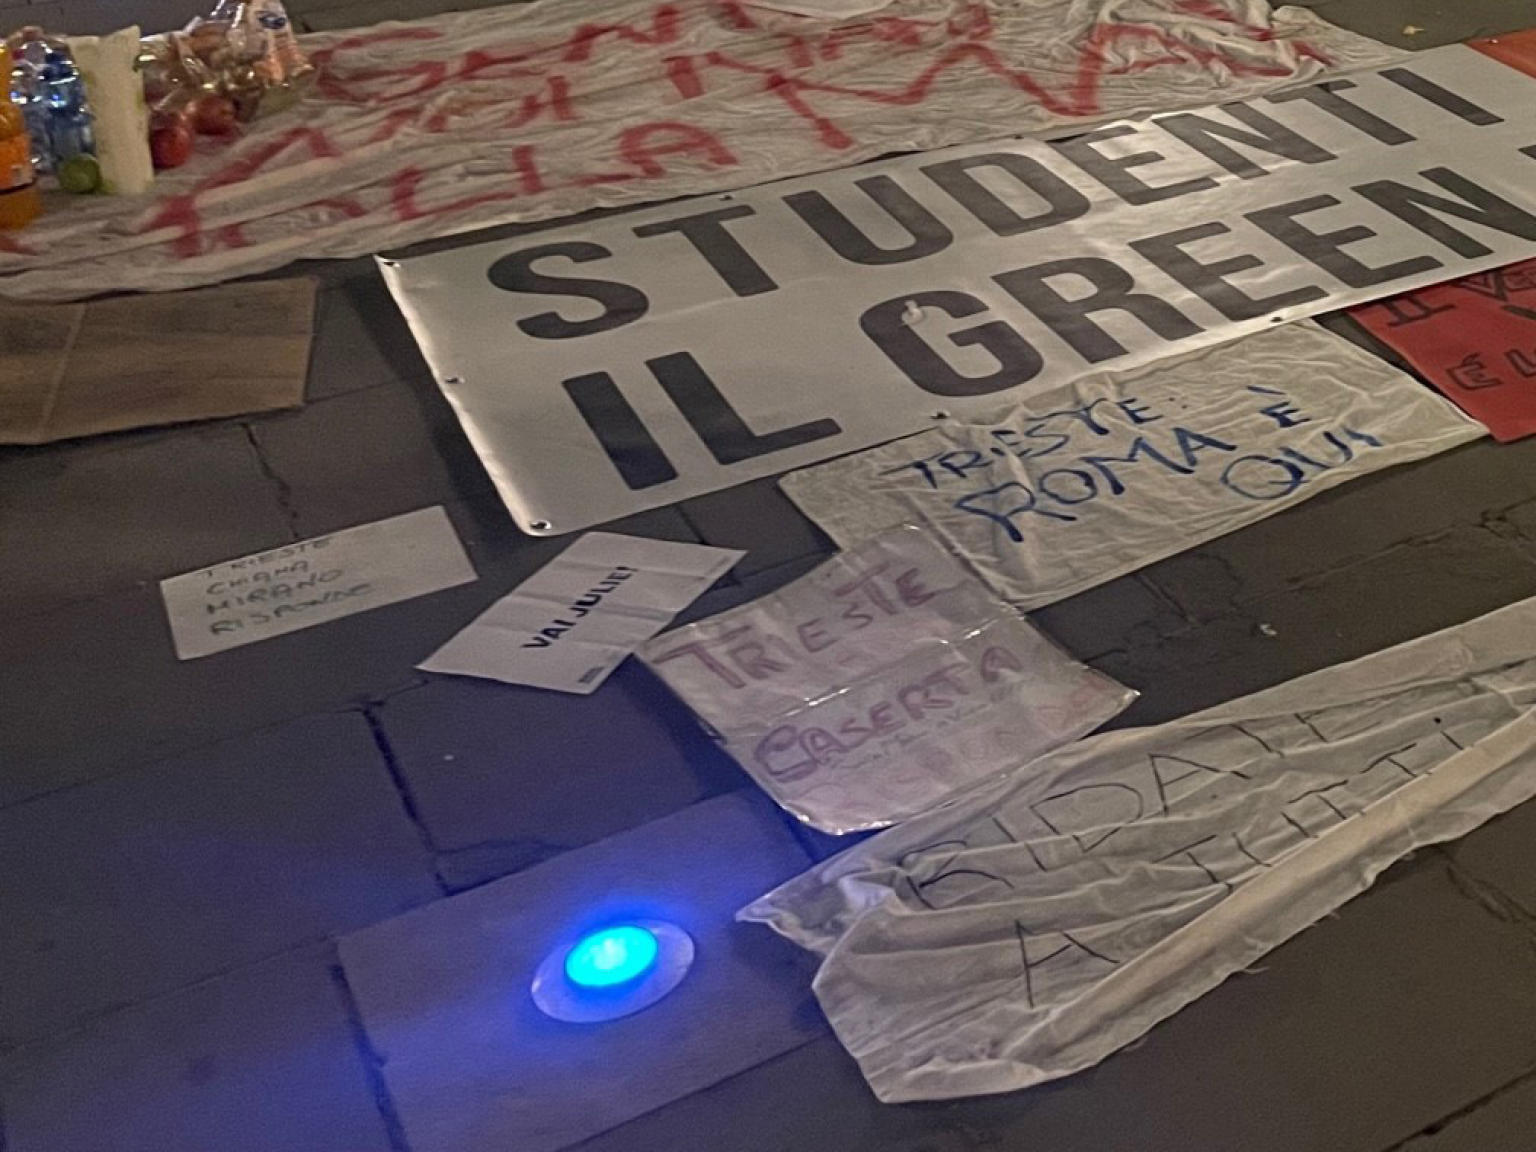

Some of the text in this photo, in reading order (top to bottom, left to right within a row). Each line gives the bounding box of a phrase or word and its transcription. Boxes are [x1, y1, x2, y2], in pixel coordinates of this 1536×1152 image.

[487, 67, 1505, 340] STUDENTI
[561, 351, 843, 490] IL
[954, 426, 1239, 543] ROMA
[522, 619, 577, 647] VAI
[754, 646, 1023, 784] CASERTA
